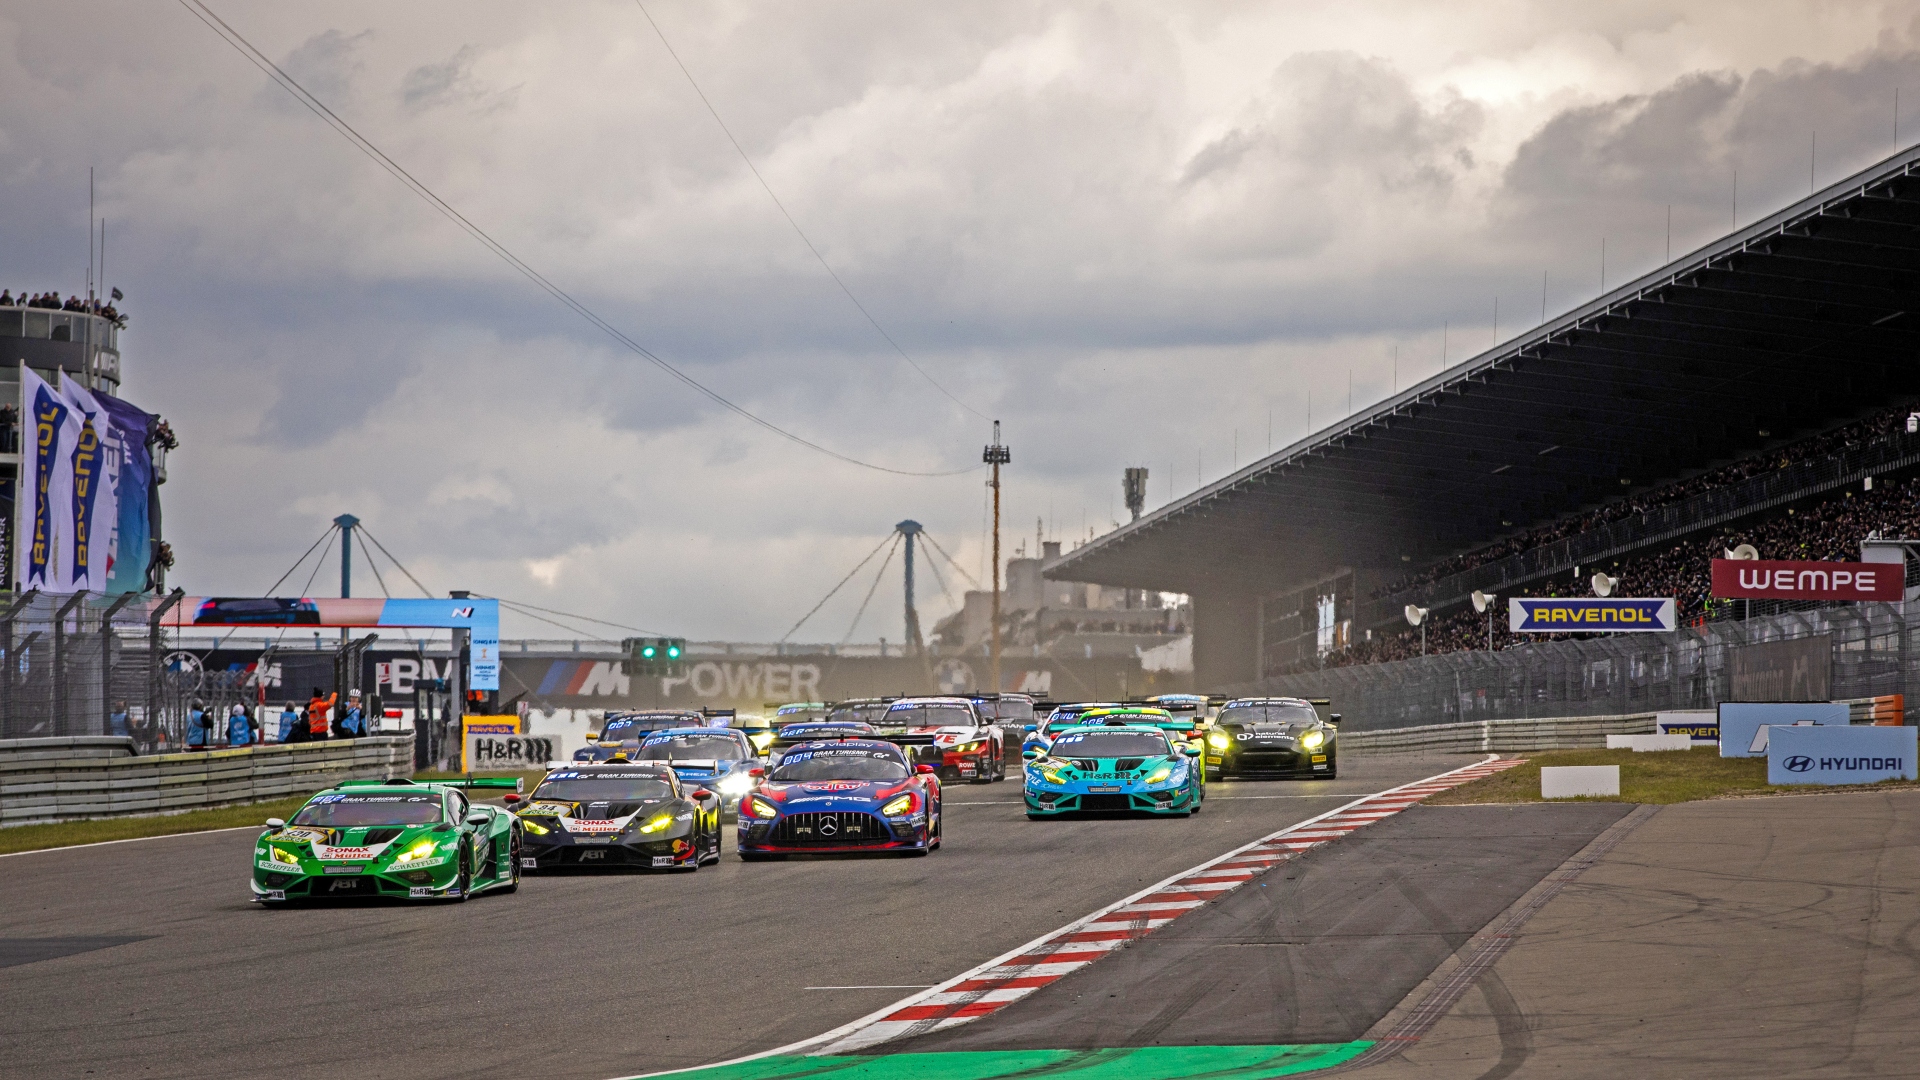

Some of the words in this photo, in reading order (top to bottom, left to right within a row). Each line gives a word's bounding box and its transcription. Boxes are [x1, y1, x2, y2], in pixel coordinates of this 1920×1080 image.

[33, 406, 59, 565] RAVEOL
[1739, 568, 1876, 591] WEMPE
[1534, 608, 1652, 623] RAVENOL
[578, 661, 630, 695] M
[661, 661, 821, 699] POWER
[783, 751, 813, 766] 004
[1820, 757, 1902, 771] HYUNDAI
[1027, 772, 1042, 786] EYLE
[578, 849, 607, 862] ABT
[260, 861, 301, 873] SCHAEFFLER
[389, 858, 441, 871] SCHAEFFLER
[328, 878, 360, 892] ABT
